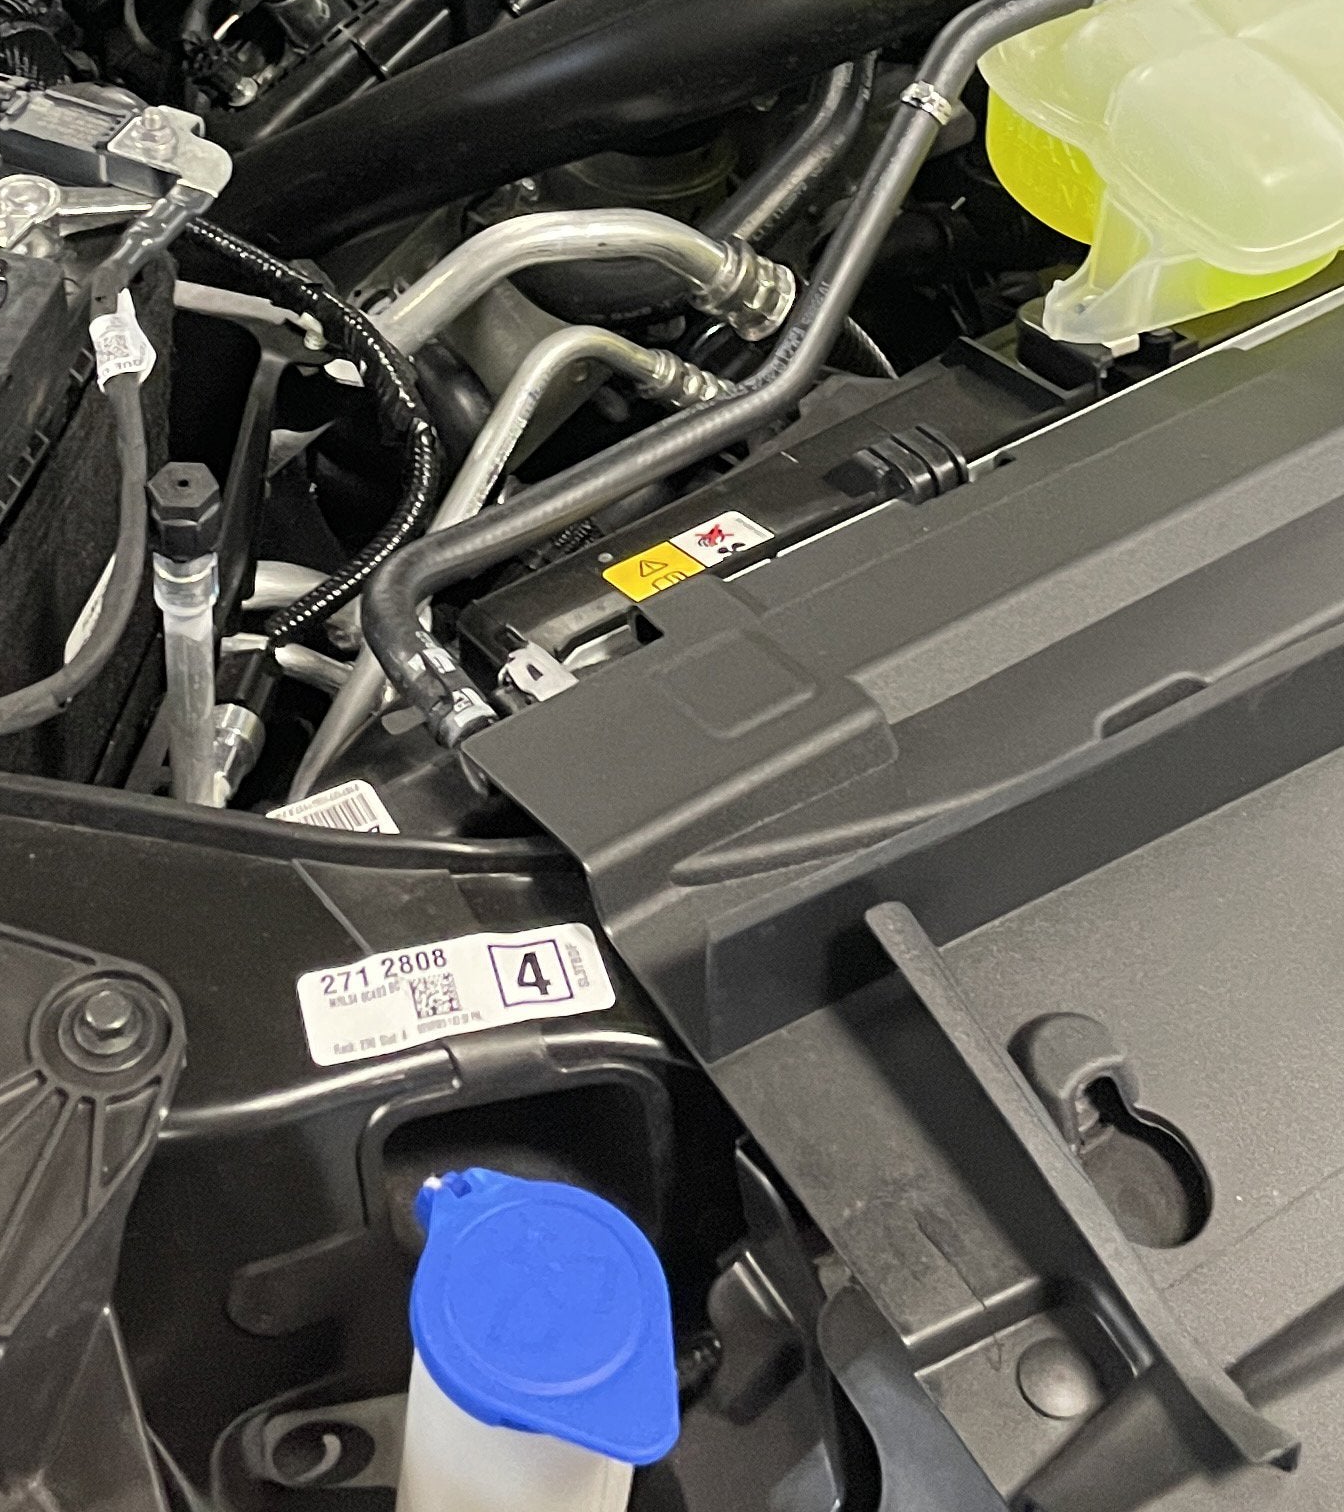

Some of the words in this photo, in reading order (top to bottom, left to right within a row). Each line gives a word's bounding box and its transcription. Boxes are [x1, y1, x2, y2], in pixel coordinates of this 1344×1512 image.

[320, 966, 370, 996] 271
[380, 948, 448, 980] 2808
[516, 951, 552, 996] 4
